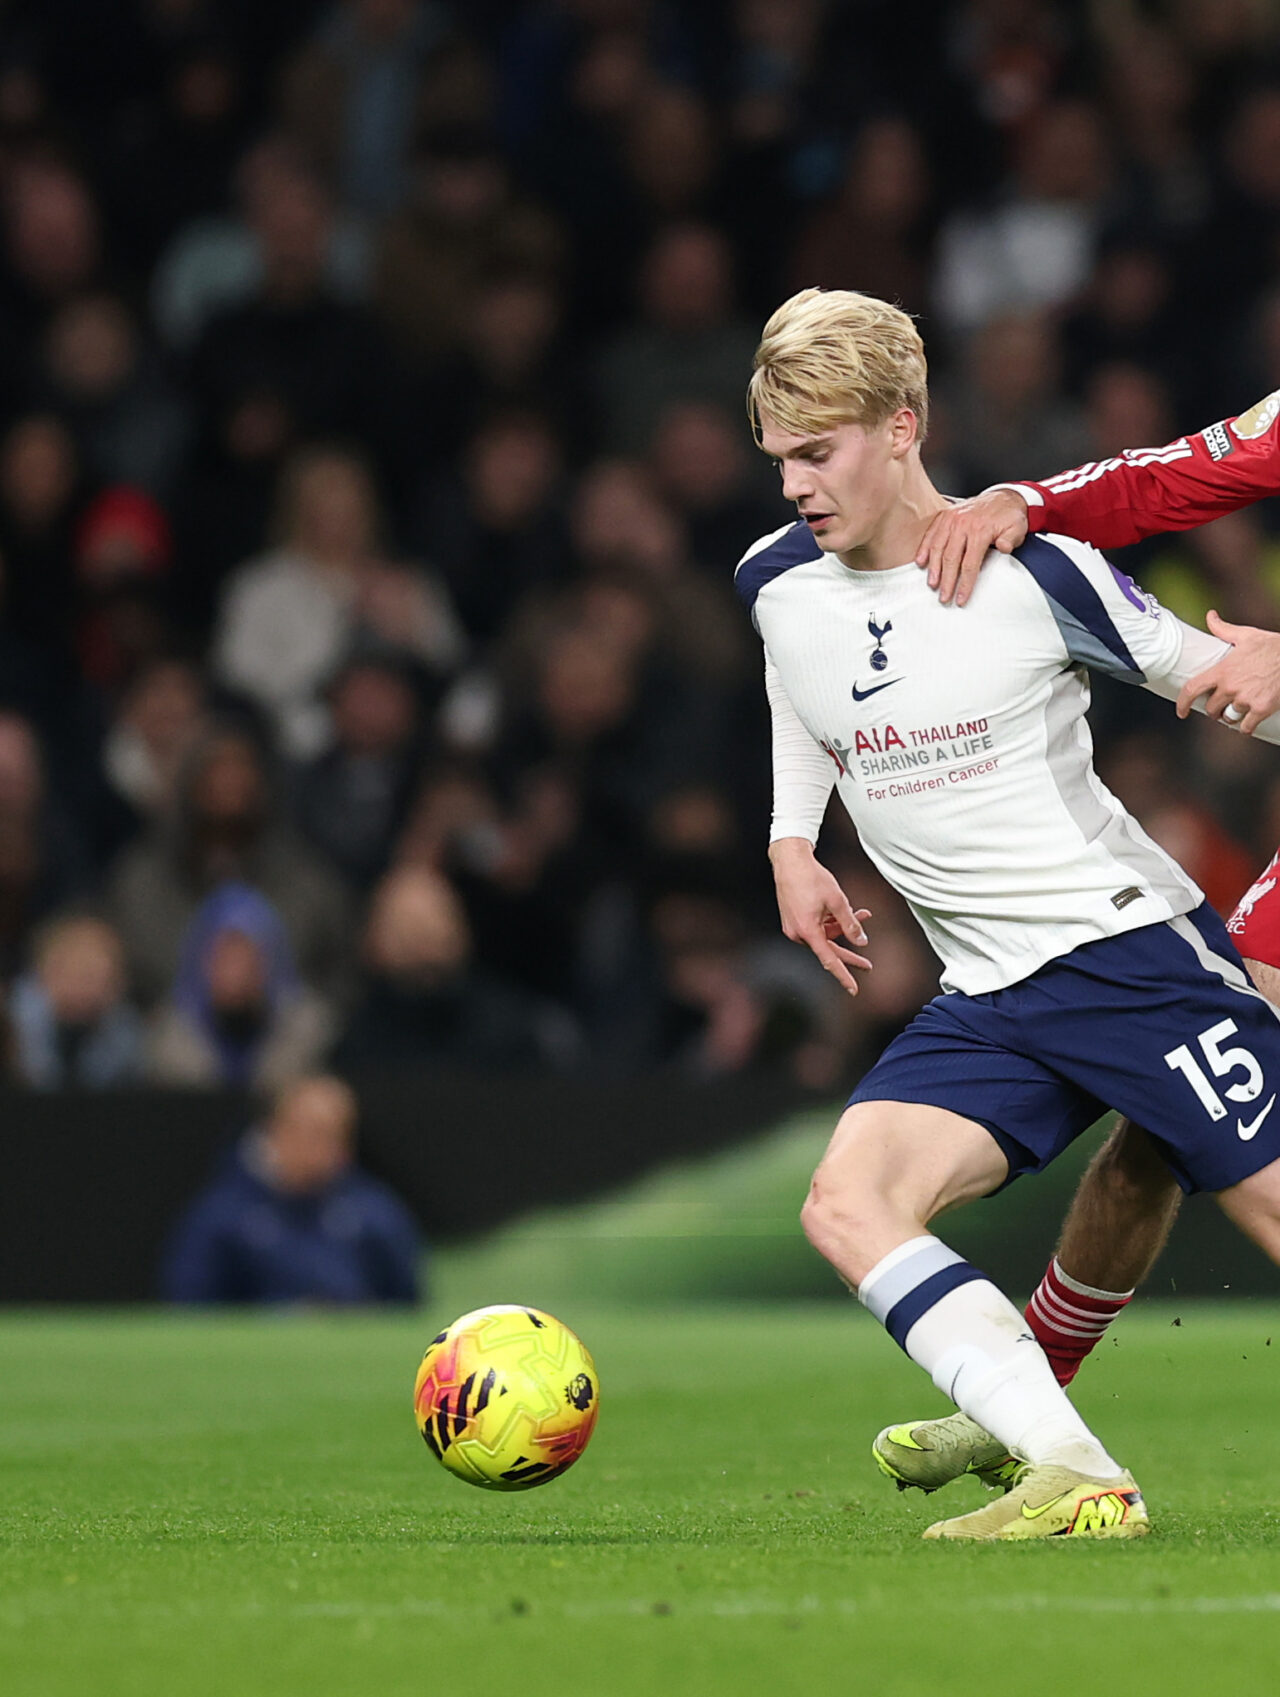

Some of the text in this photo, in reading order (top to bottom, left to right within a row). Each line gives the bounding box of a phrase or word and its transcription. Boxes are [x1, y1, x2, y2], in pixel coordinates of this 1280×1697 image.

[855, 718, 989, 756] AIA THAILAND
[861, 734, 994, 776] SHARING A LIFE
[867, 758, 1000, 801] For Children Cancer
[1163, 1017, 1264, 1122] 15
